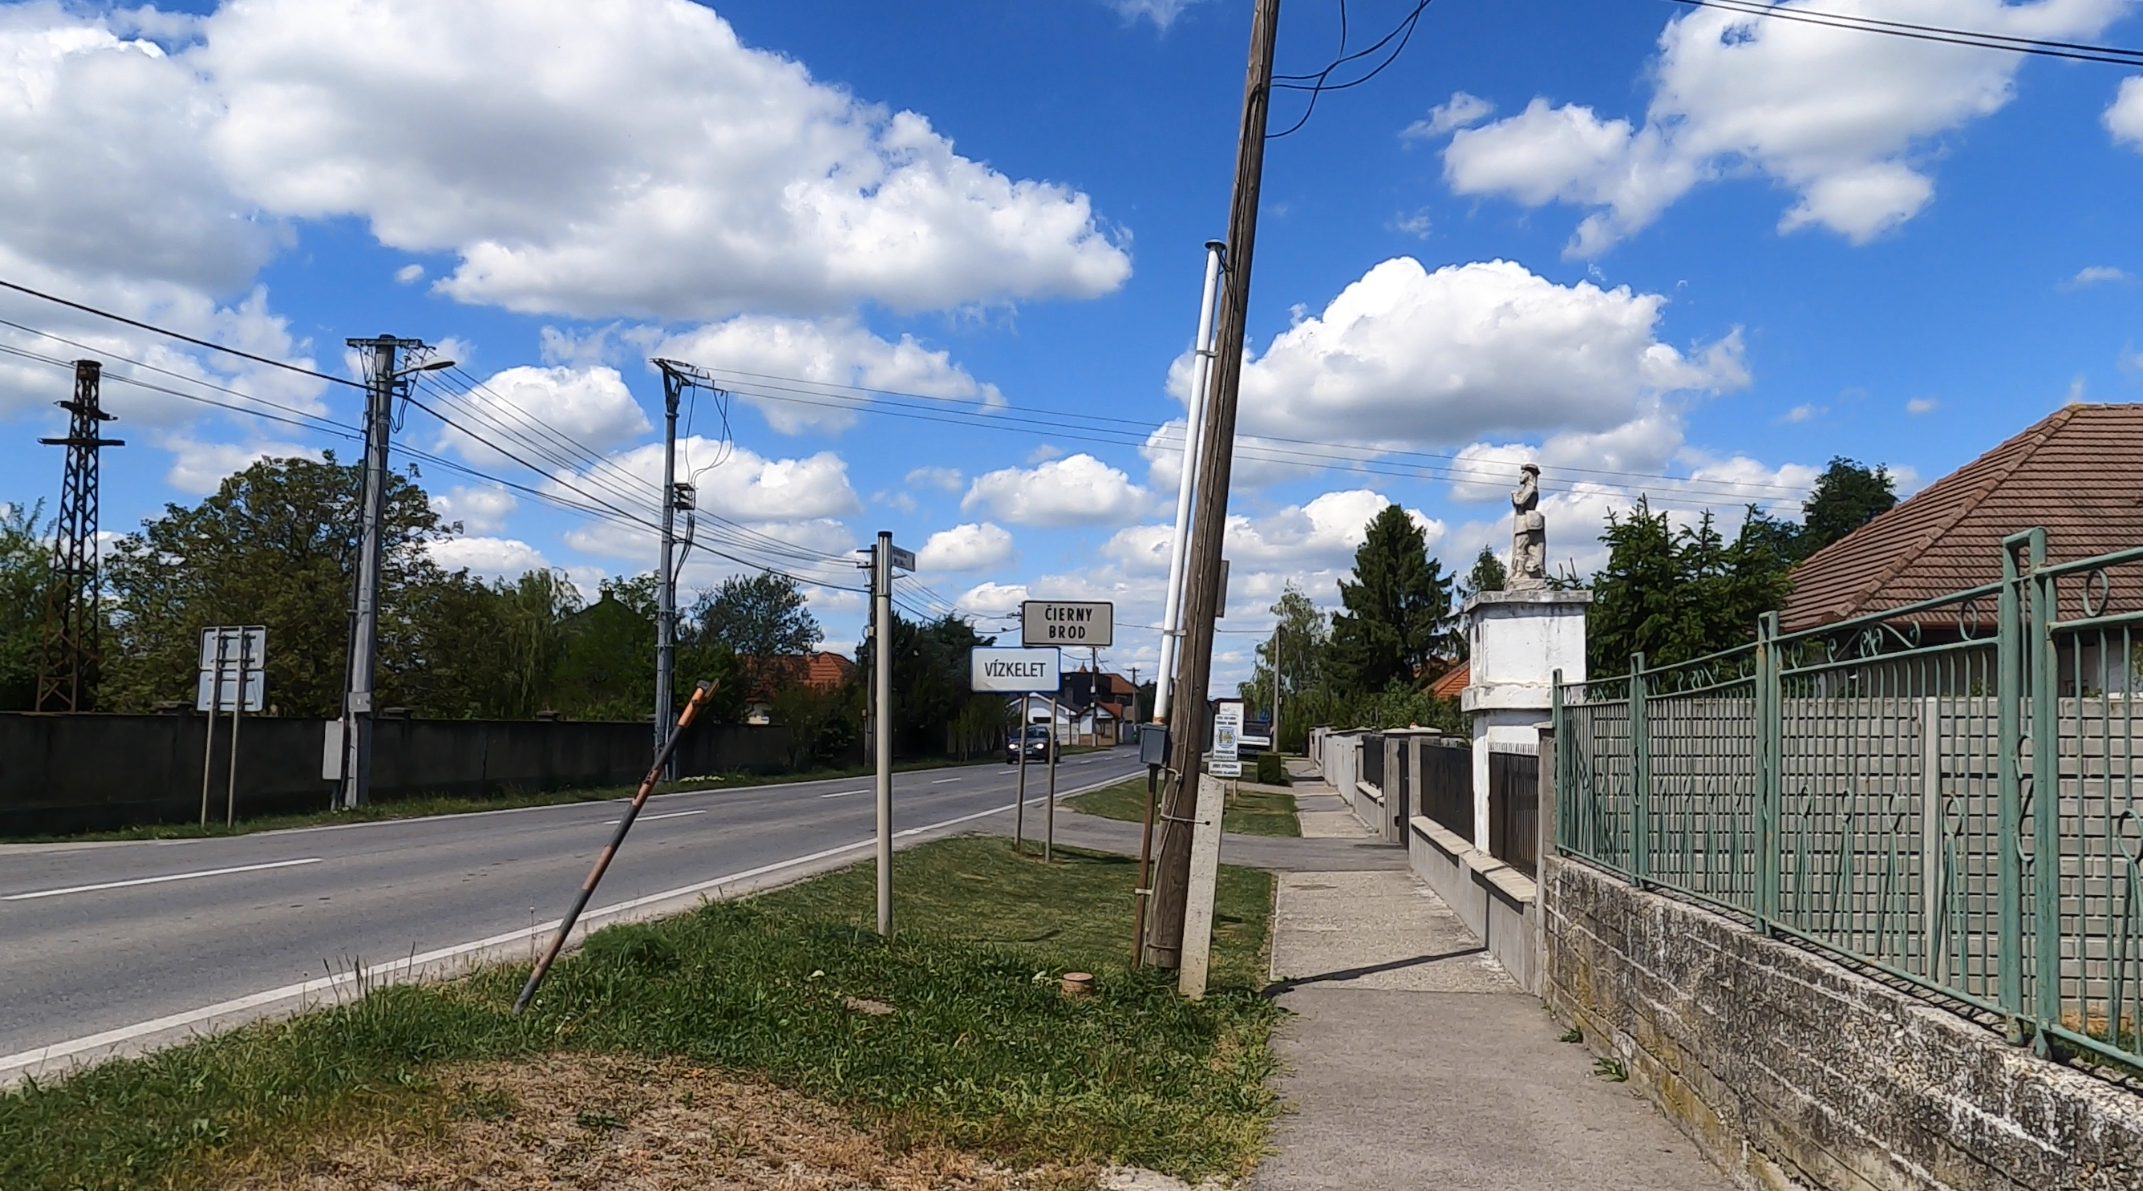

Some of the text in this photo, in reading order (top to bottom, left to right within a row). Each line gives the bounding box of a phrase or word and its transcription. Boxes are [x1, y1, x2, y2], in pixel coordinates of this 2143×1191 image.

[1045, 604, 1093, 622] ČIERNY
[1049, 625, 1086, 639] BROD
[984, 658, 1047, 678] VÍZKELET
